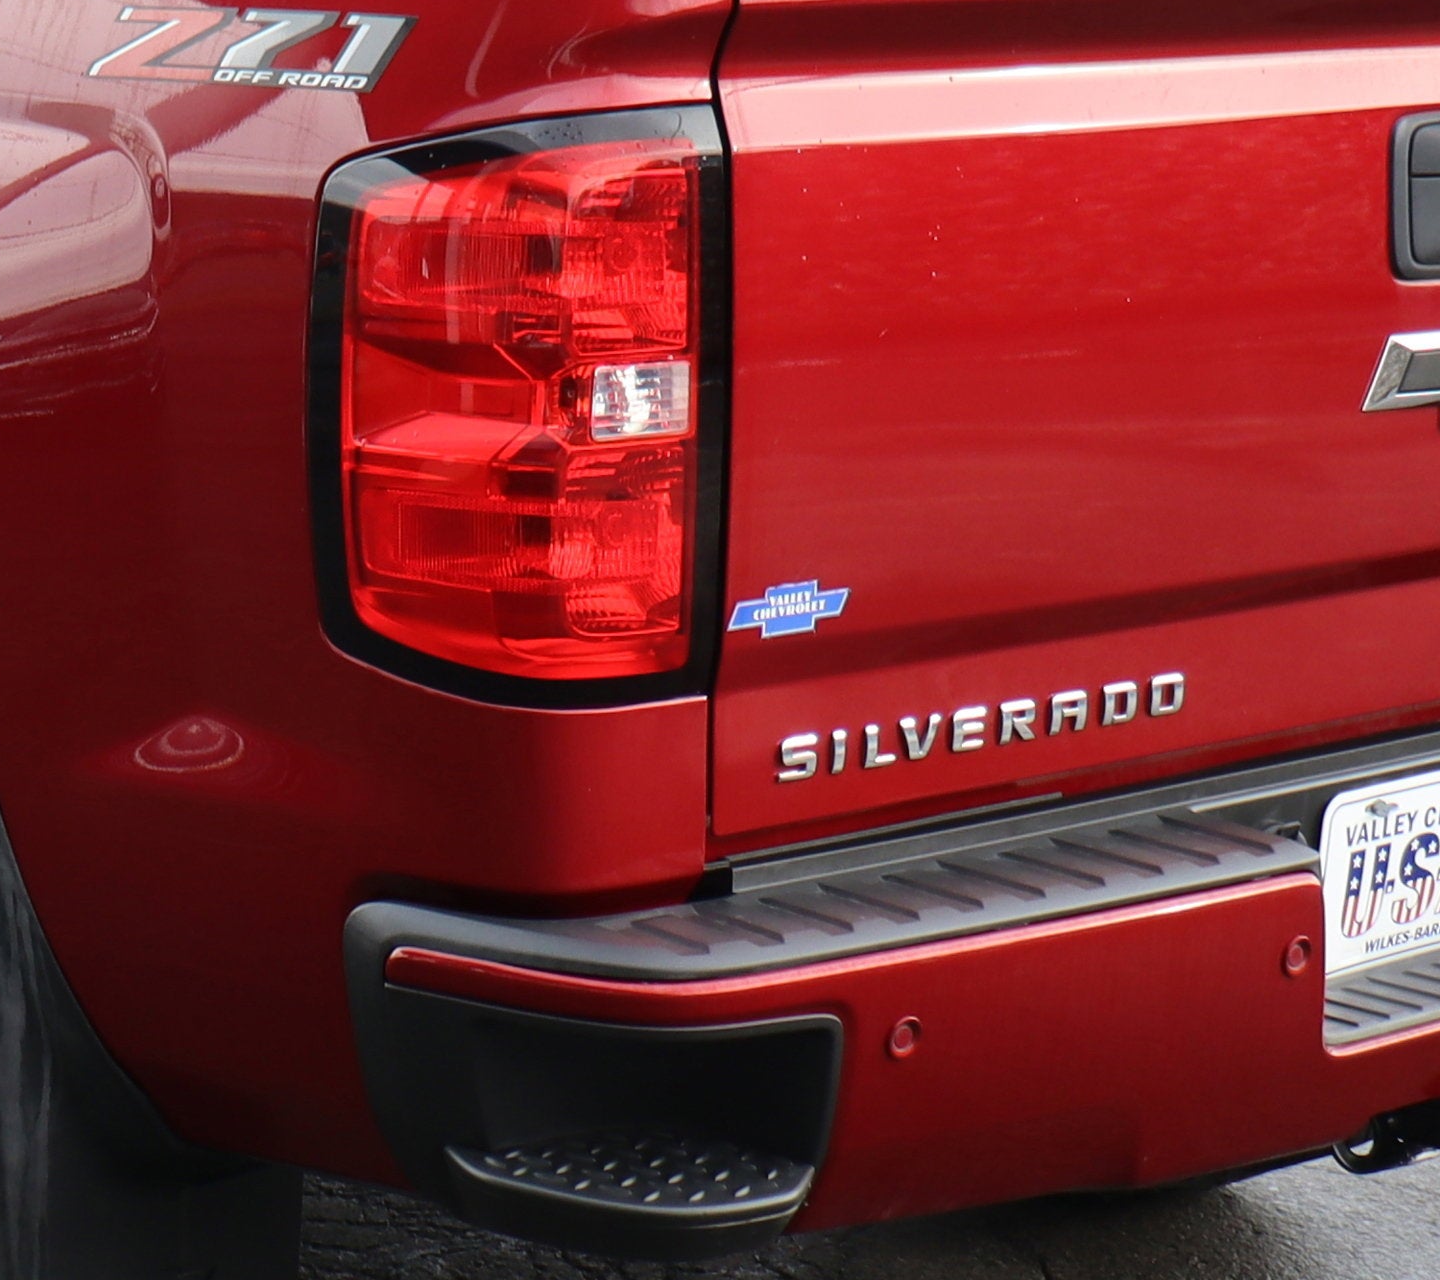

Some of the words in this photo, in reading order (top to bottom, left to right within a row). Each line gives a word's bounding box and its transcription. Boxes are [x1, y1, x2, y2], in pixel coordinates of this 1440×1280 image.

[86, 5, 418, 81] Z71
[214, 70, 274, 84] OFF
[278, 72, 369, 91] ROAD
[753, 599, 826, 620] CHEVROLET
[769, 591, 812, 607] VALLEY
[777, 671, 1186, 783] SILVERADO
[1346, 810, 1419, 847] VALLEY
